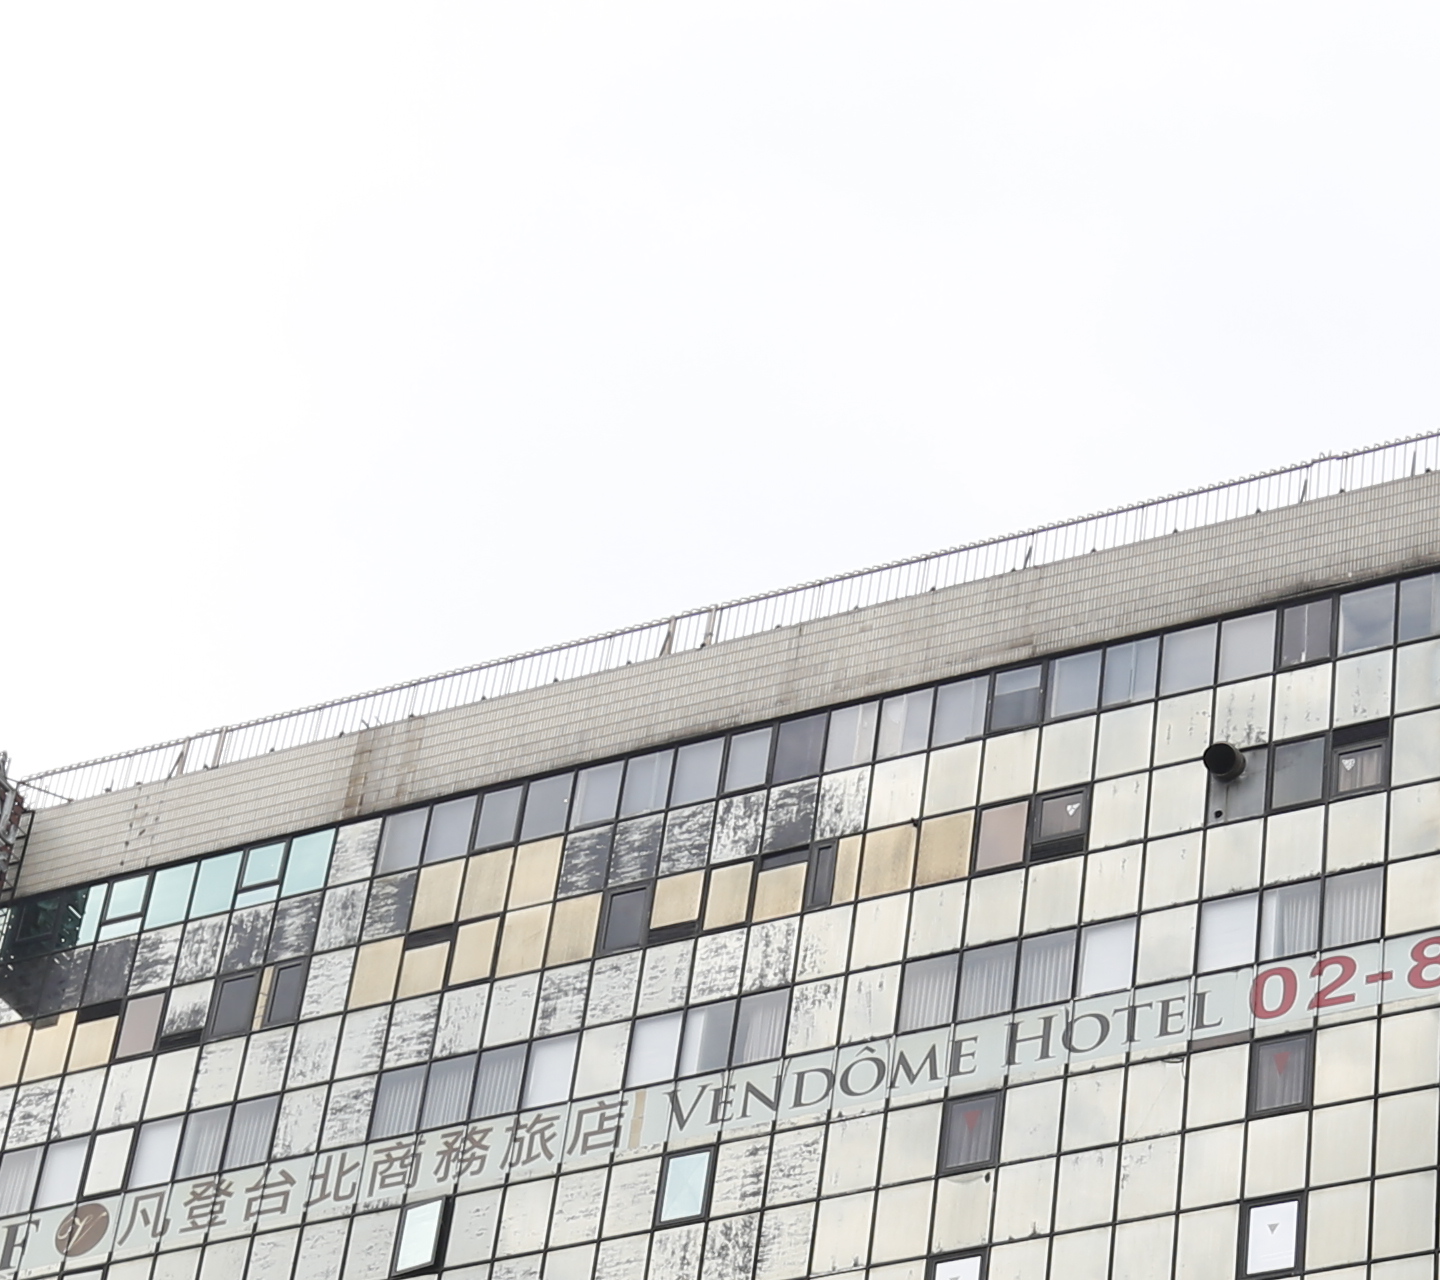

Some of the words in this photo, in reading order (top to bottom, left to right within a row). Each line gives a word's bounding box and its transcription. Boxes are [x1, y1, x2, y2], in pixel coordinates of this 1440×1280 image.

[664, 1031, 978, 1134] VENDÔME
[1004, 990, 1224, 1084] HOTEL
[117, 1098, 627, 1247] 凡登台北商務旅店
